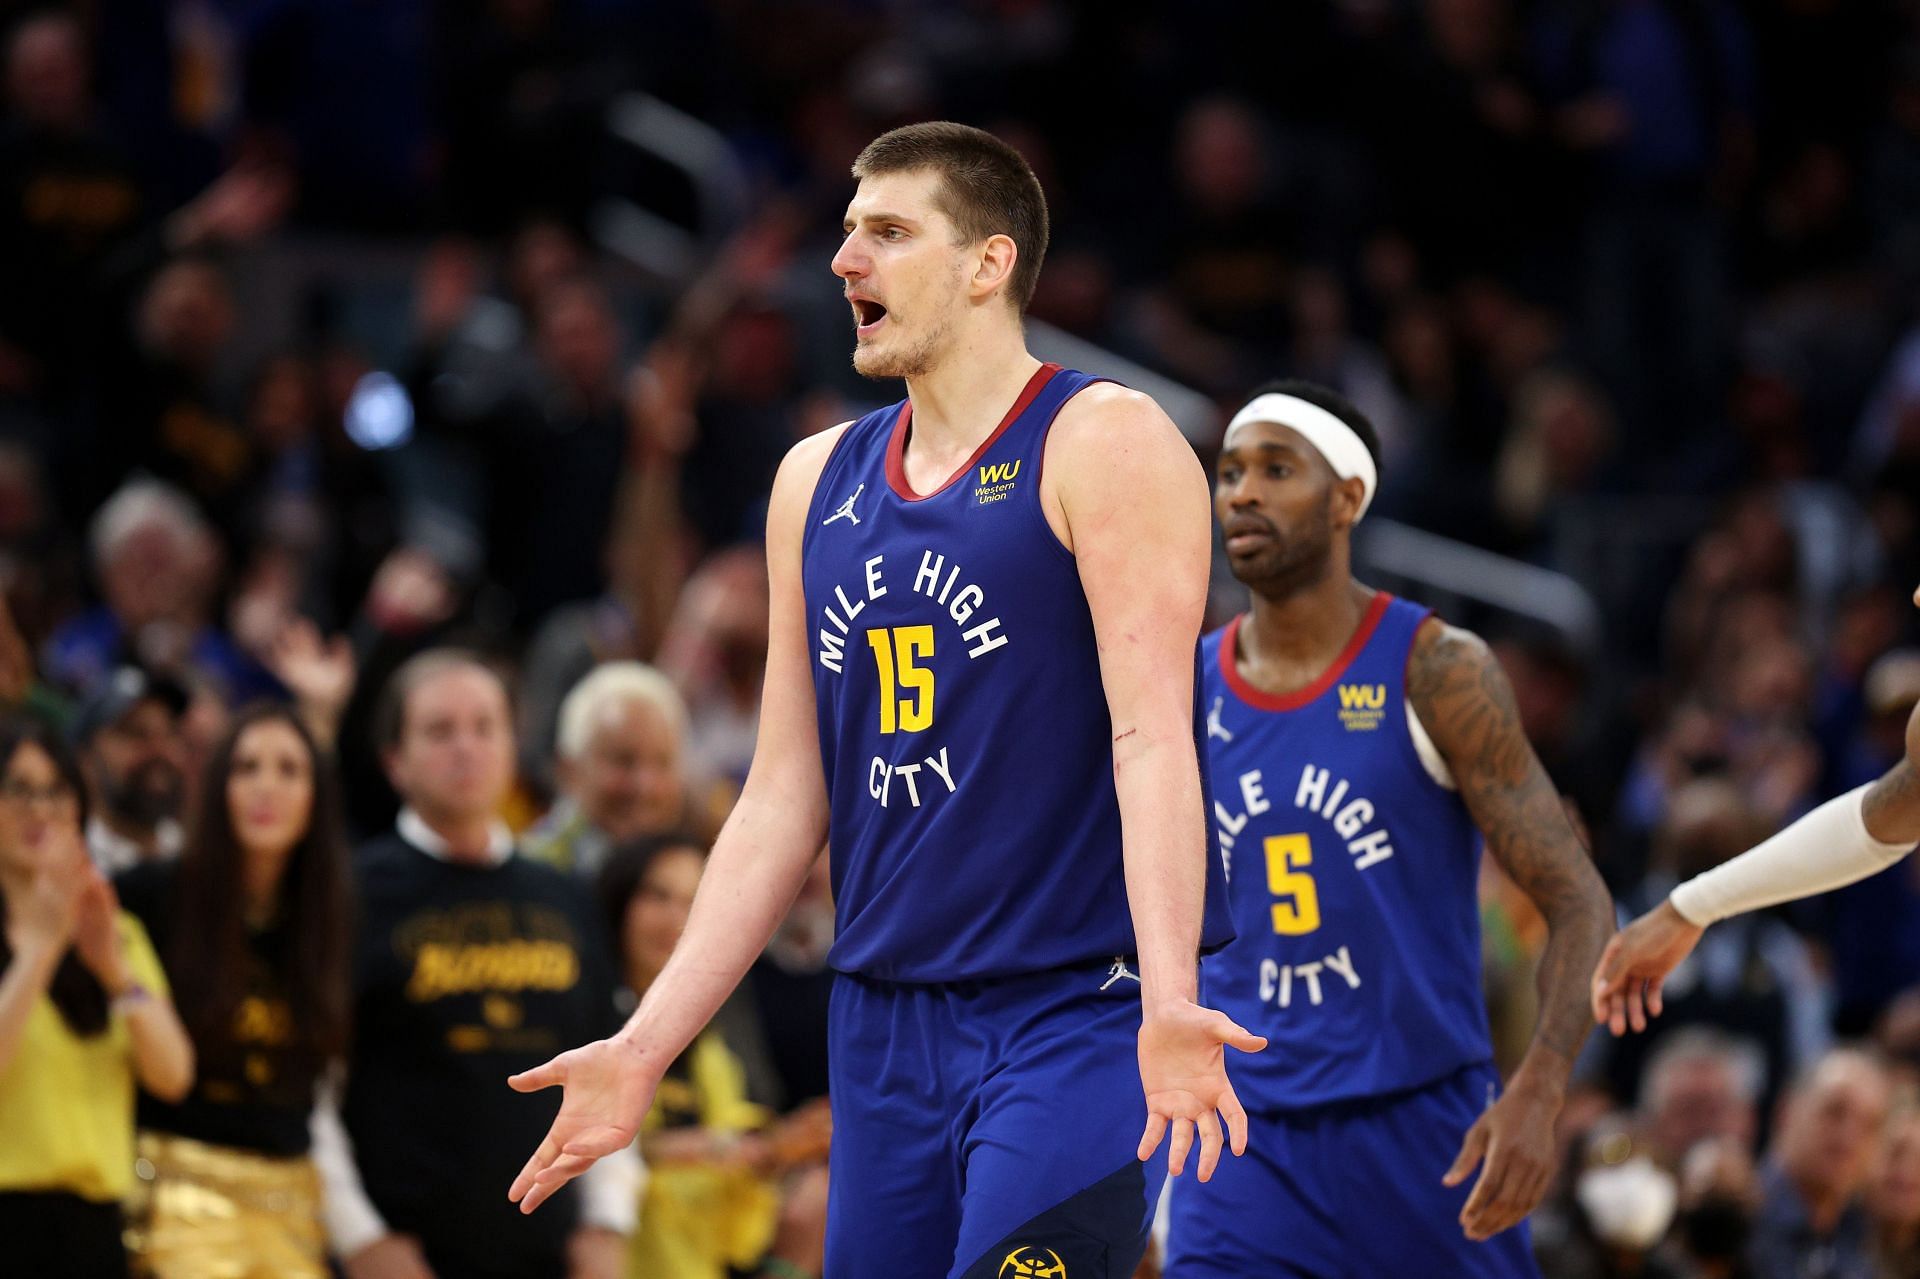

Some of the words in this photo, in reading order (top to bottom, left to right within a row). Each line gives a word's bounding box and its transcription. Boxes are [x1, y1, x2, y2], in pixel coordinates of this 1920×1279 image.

[975, 482, 1015, 497] Western
[979, 492, 1007, 504] Union
[980, 459, 1021, 485] WU
[819, 554, 888, 674] MILE
[913, 549, 1009, 660] HIGH
[866, 624, 935, 734] 15
[1338, 683, 1386, 709] WU
[868, 746, 957, 808] CITY
[1214, 768, 1271, 885] ILE
[1294, 763, 1394, 871] HIGH
[1263, 832, 1321, 936] 5
[1258, 945, 1361, 1009] CITY
